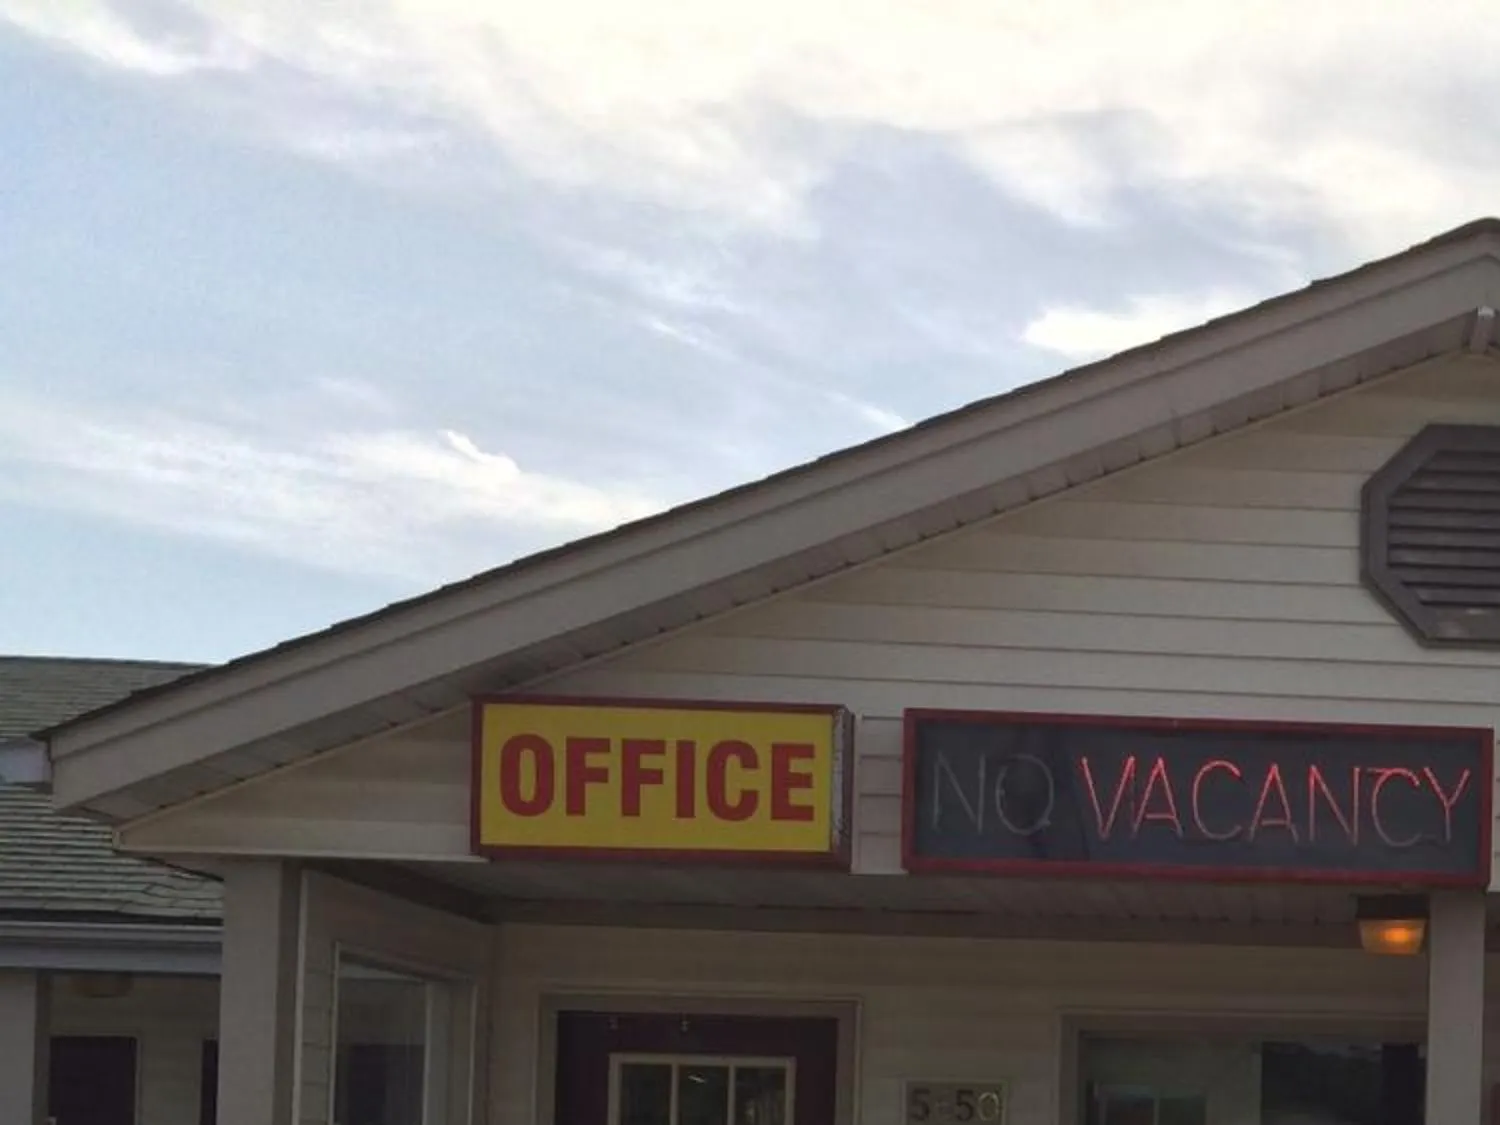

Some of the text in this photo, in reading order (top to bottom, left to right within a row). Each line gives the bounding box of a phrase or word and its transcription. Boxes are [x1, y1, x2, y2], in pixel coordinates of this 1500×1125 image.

[500, 733, 816, 822] OFFICE
[931, 750, 1470, 847] NO VACANCY
